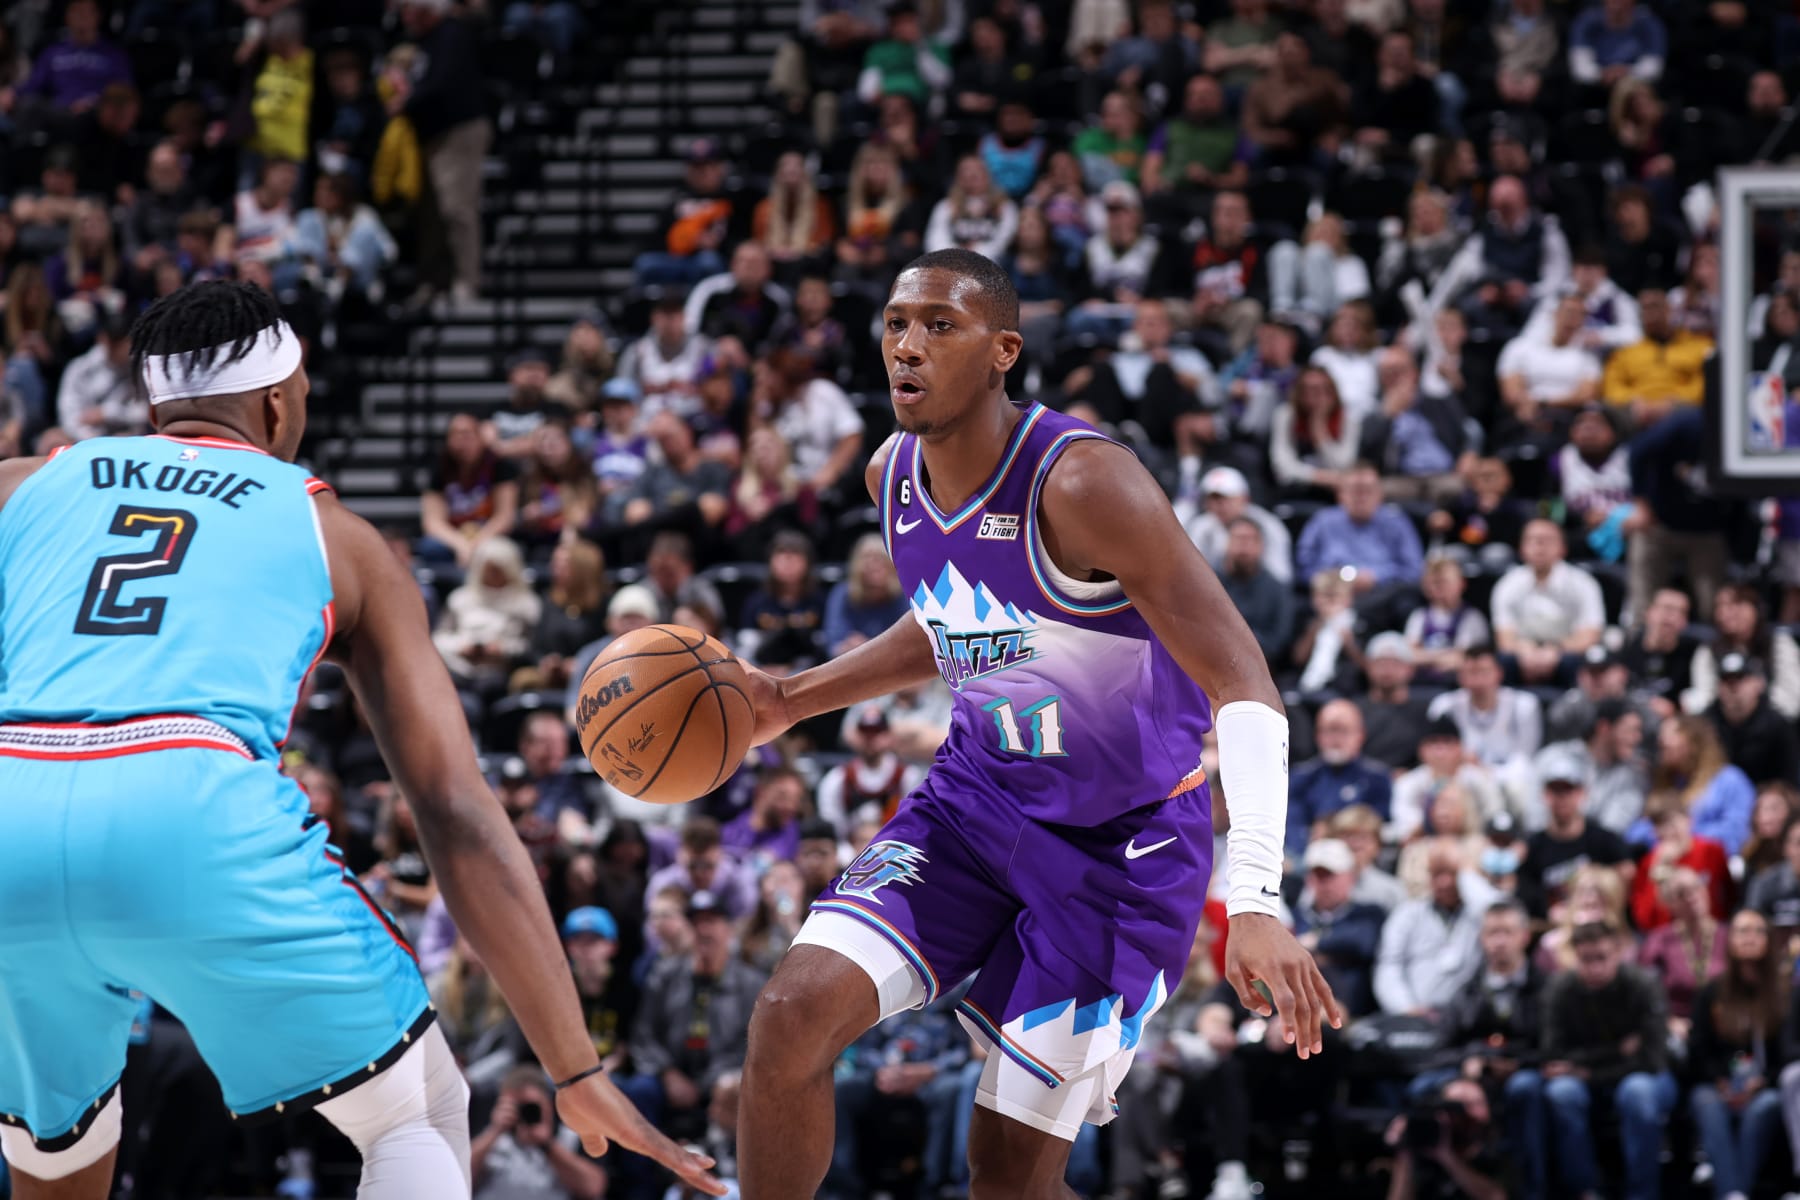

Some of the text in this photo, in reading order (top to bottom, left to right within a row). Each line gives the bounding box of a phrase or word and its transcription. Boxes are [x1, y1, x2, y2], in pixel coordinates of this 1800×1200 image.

[91, 457, 266, 509] OKOGIE
[901, 479, 911, 504] 6
[981, 516, 993, 536] 5
[993, 527, 1016, 537] FIGHT
[73, 504, 198, 636] 2
[928, 621, 1034, 691] JAZZ
[576, 675, 634, 733] ilson
[984, 696, 1067, 757] 11
